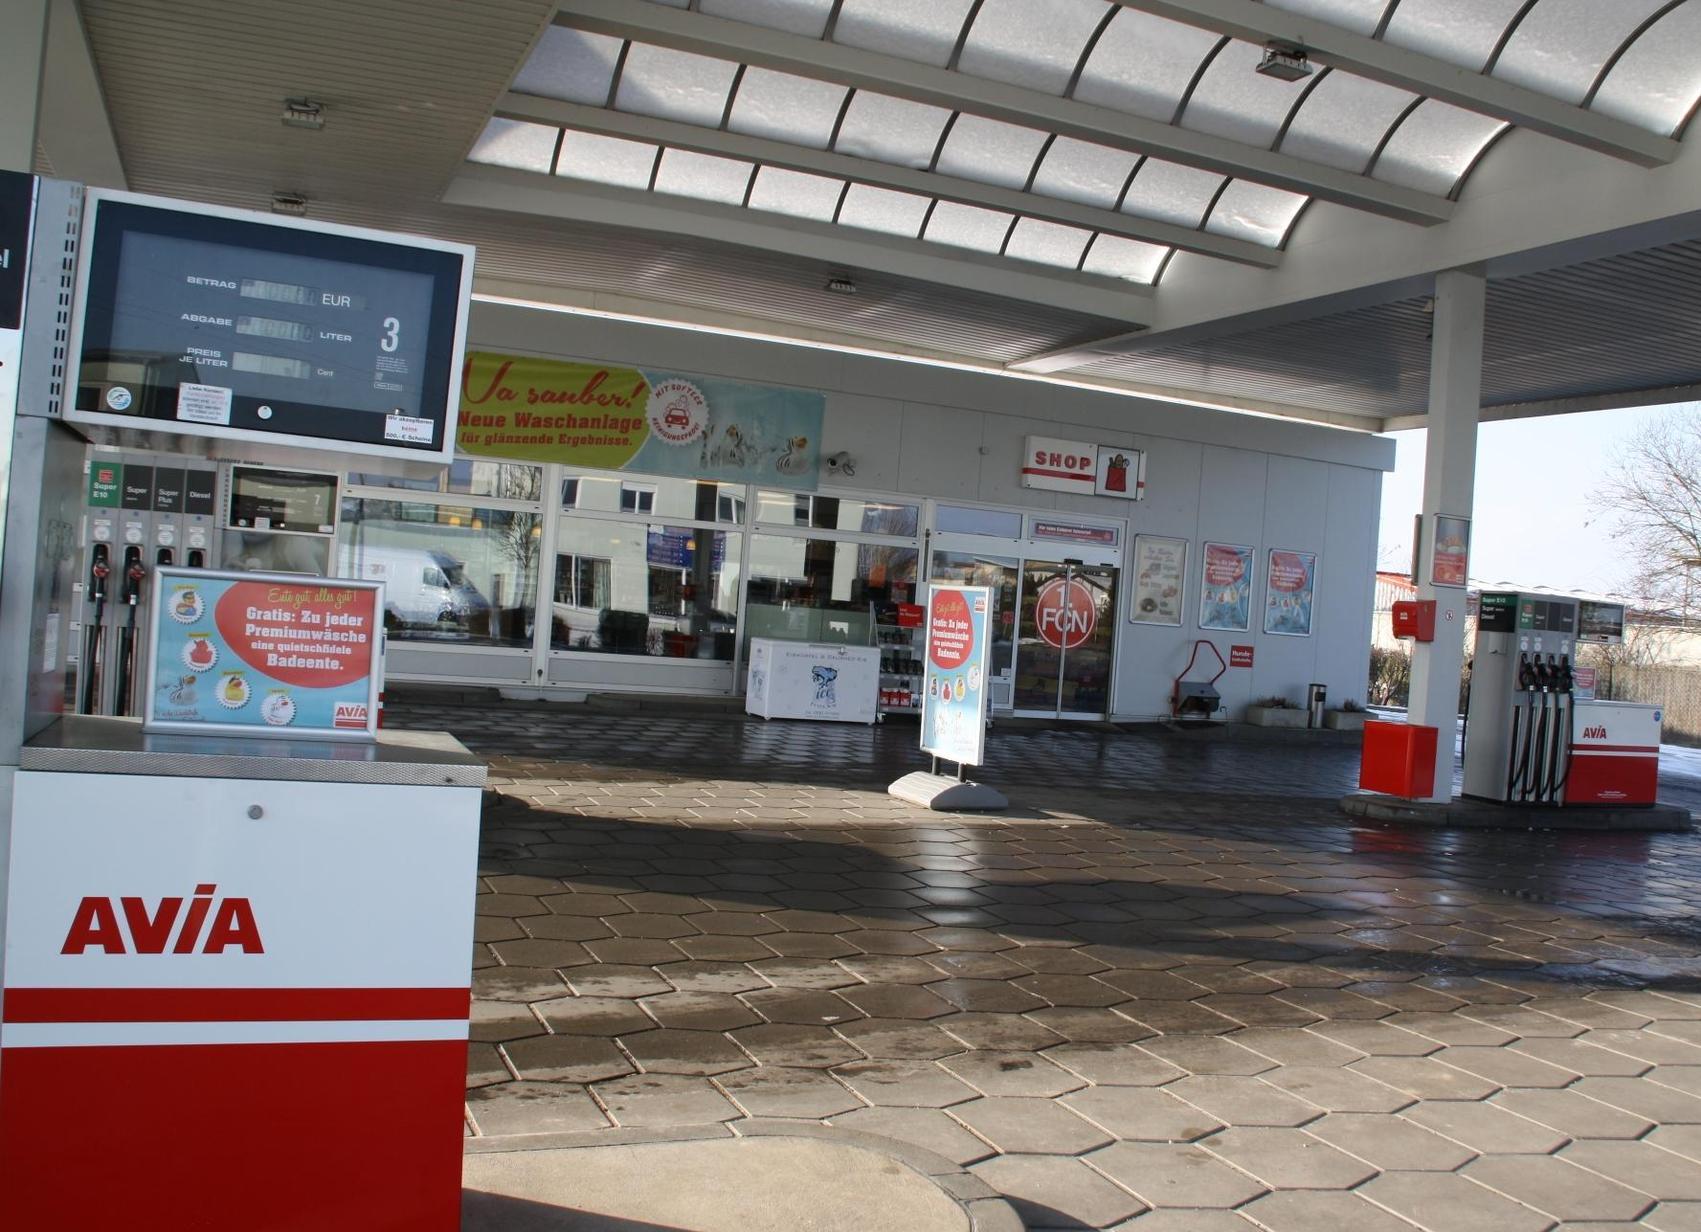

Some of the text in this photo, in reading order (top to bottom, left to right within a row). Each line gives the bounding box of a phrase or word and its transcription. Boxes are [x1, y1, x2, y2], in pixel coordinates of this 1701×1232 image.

[186, 276, 237, 289] BETRAG
[322, 293, 351, 308] EUR
[181, 313, 233, 327] ABGABE
[320, 331, 353, 343] LITER
[380, 317, 400, 352] 3
[187, 347, 222, 358] PREIS
[179, 355, 228, 368] JE LITER
[527, 370, 647, 408] sauber!
[655, 385, 670, 399] MIT
[458, 410, 642, 433] Neue Waschanlage
[461, 431, 633, 446] für glänzende Ergebnisse.
[1035, 450, 1092, 470] SHOP
[93, 482, 117, 491] Super
[126, 486, 148, 494] Super
[158, 489, 179, 497] Super
[158, 496, 173, 504] Plus
[189, 491, 211, 499] Diesel
[246, 606, 364, 628] Gratis: Zu jeder
[1041, 607, 1088, 633] FCN
[245, 623, 367, 643] Premiumwäsche
[251, 640, 275, 650] eine
[267, 653, 344, 670] Badeente.
[60, 884, 265, 954] AVIA
